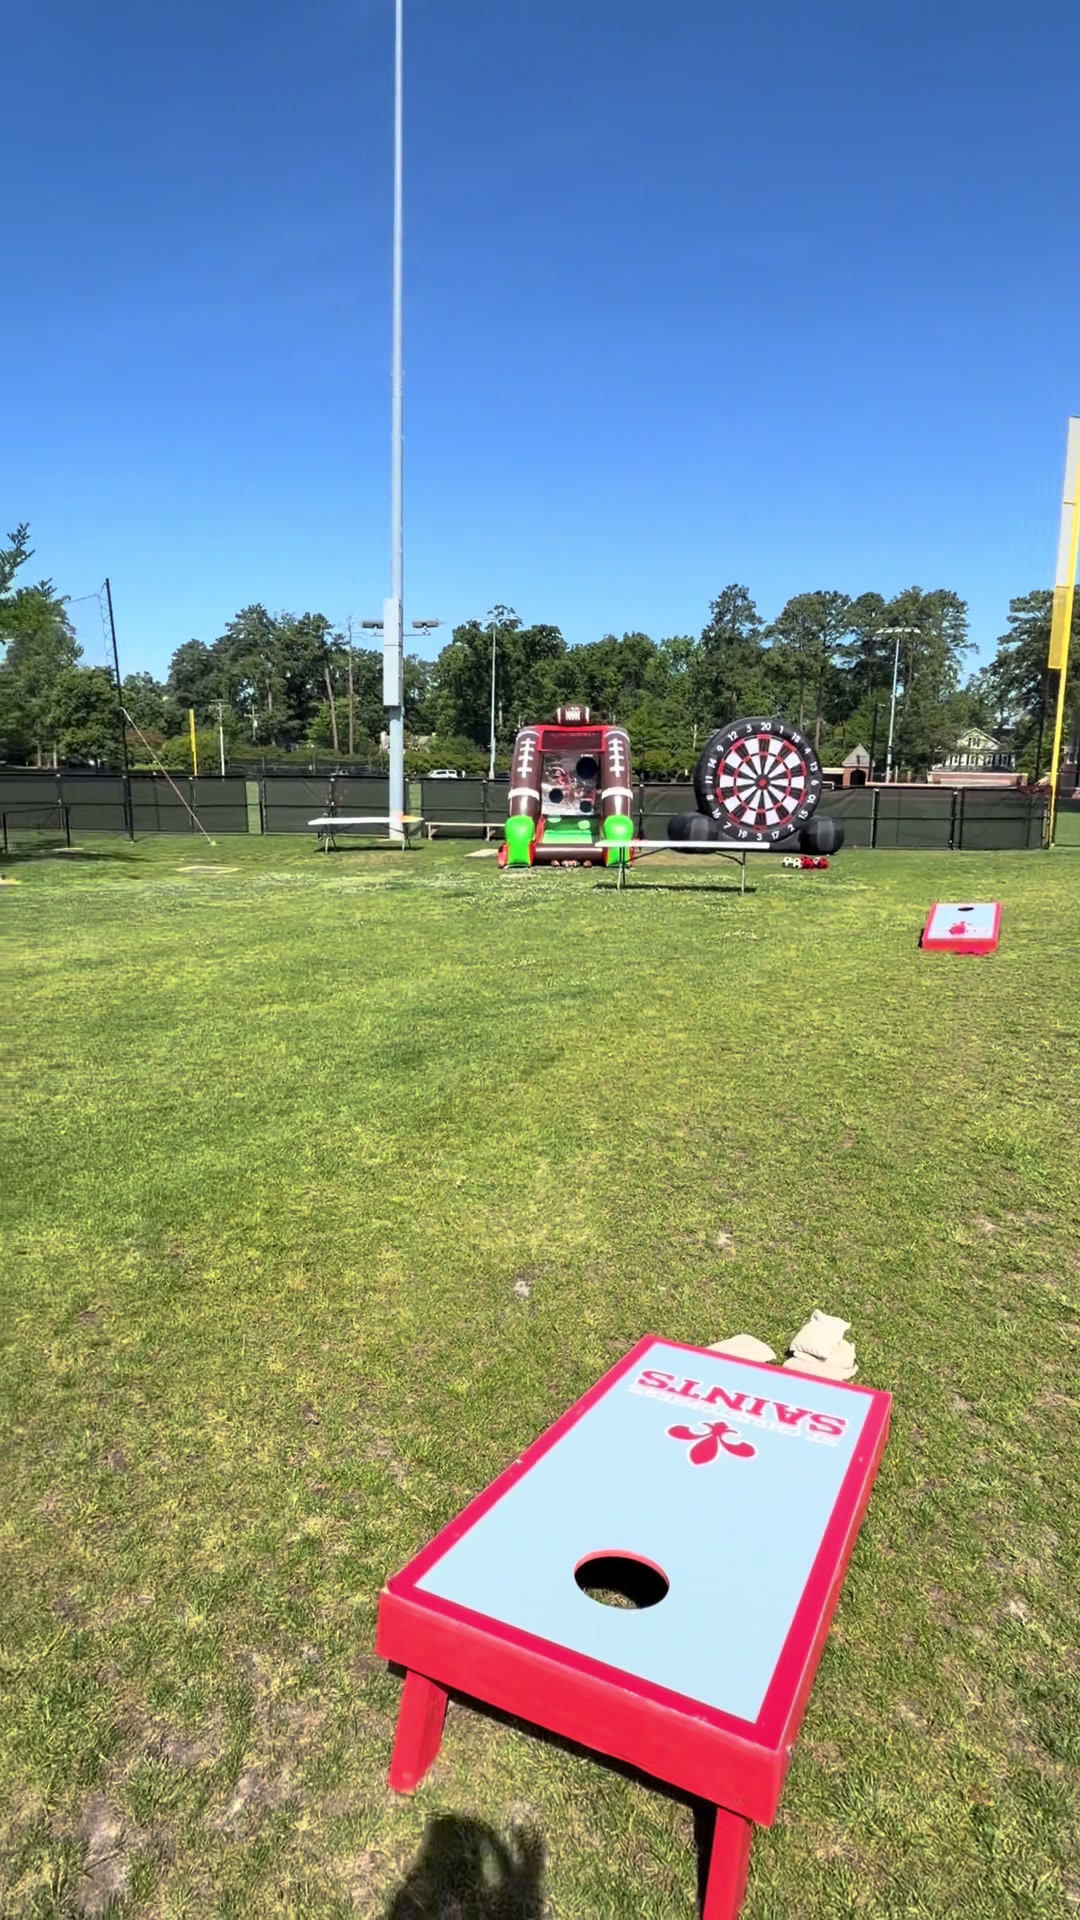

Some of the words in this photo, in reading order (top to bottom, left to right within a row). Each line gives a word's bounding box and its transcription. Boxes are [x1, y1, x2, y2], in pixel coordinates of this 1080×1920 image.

[746, 724, 752, 732] 5
[761, 722, 771, 732] 20
[779, 725, 784, 734] 1
[727, 731, 738, 741] 12
[708, 757, 717, 768] 14
[809, 761, 818, 772] 13
[705, 775, 713, 784] 11
[807, 794, 816, 804] 10
[712, 808, 721, 819] 16
[798, 810, 808, 820] 15
[787, 823, 795, 832] 2
[738, 829, 748, 838] 19
[756, 833, 763, 841] 3
[771, 830, 780, 840] 17
[637, 1369, 847, 1437] SAINTS
